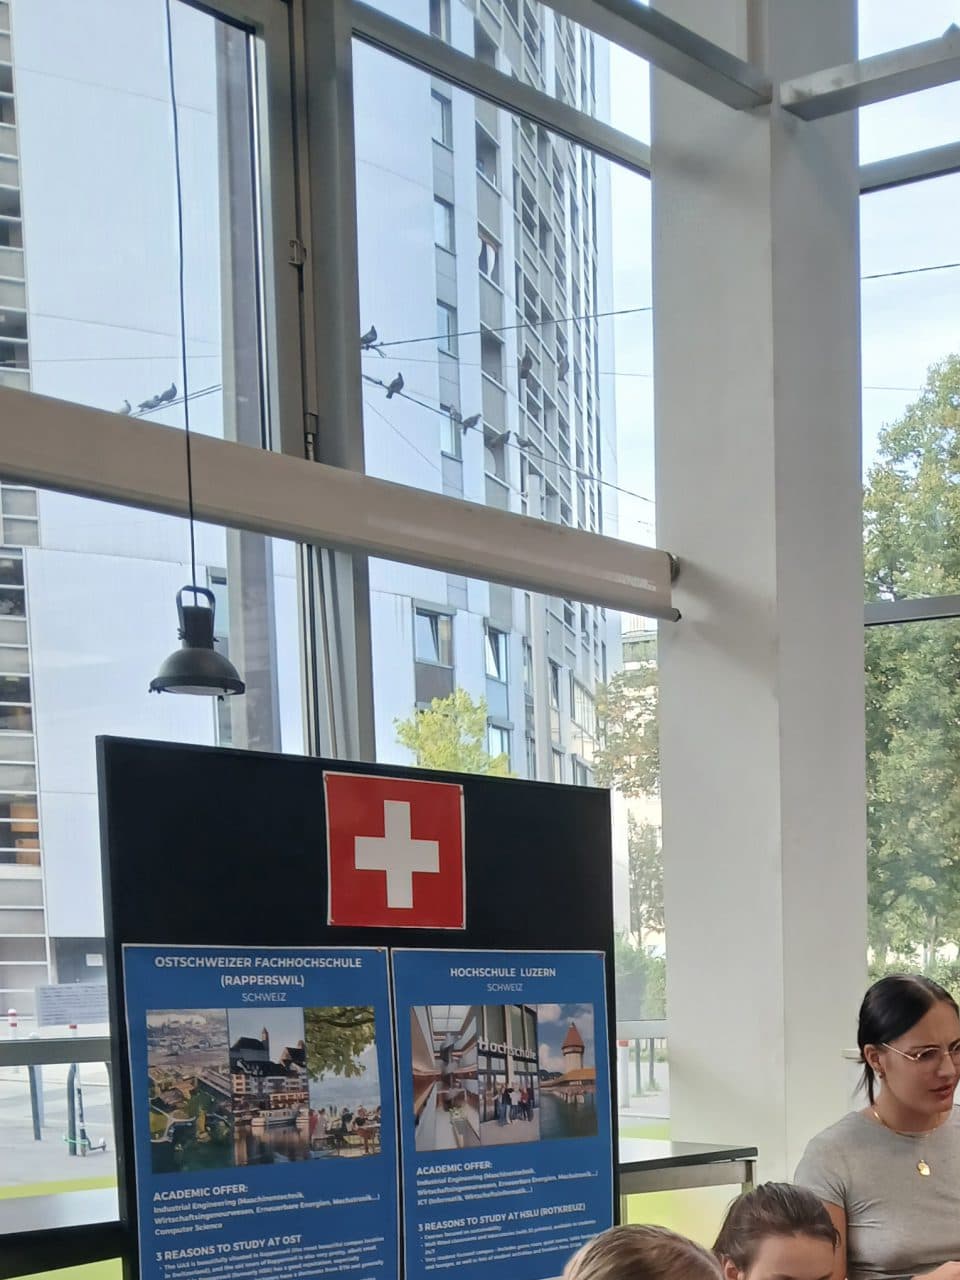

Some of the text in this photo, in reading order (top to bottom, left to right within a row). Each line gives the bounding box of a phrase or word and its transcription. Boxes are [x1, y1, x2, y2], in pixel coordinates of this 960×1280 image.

[154, 956, 362, 968] OSTSCHWEIZER FACHHOCHSCHULE
[450, 968, 556, 977] HOCHSCHULE LUZERN
[220, 974, 305, 988] (RAPPERSWIL)
[487, 983, 523, 992] SCHWEIZ
[242, 992, 286, 1002] SCHWEIZ
[416, 1160, 493, 1176] ACADEMIC OFFER:
[153, 1184, 248, 1201] ACADEMIC OFFER:
[154, 1204, 191, 1214] Industrial
[424, 1218, 466, 1232] REASONS
[466, 1217, 478, 1226] TO
[480, 1214, 506, 1224] STUDY
[508, 1212, 519, 1220] AT
[520, 1209, 539, 1218] HSLU
[540, 1202, 586, 1216] (ROTKREUZ)
[154, 1226, 194, 1236] Computer
[156, 1234, 302, 1262] 3 REASONS TO STUDY AT OST
